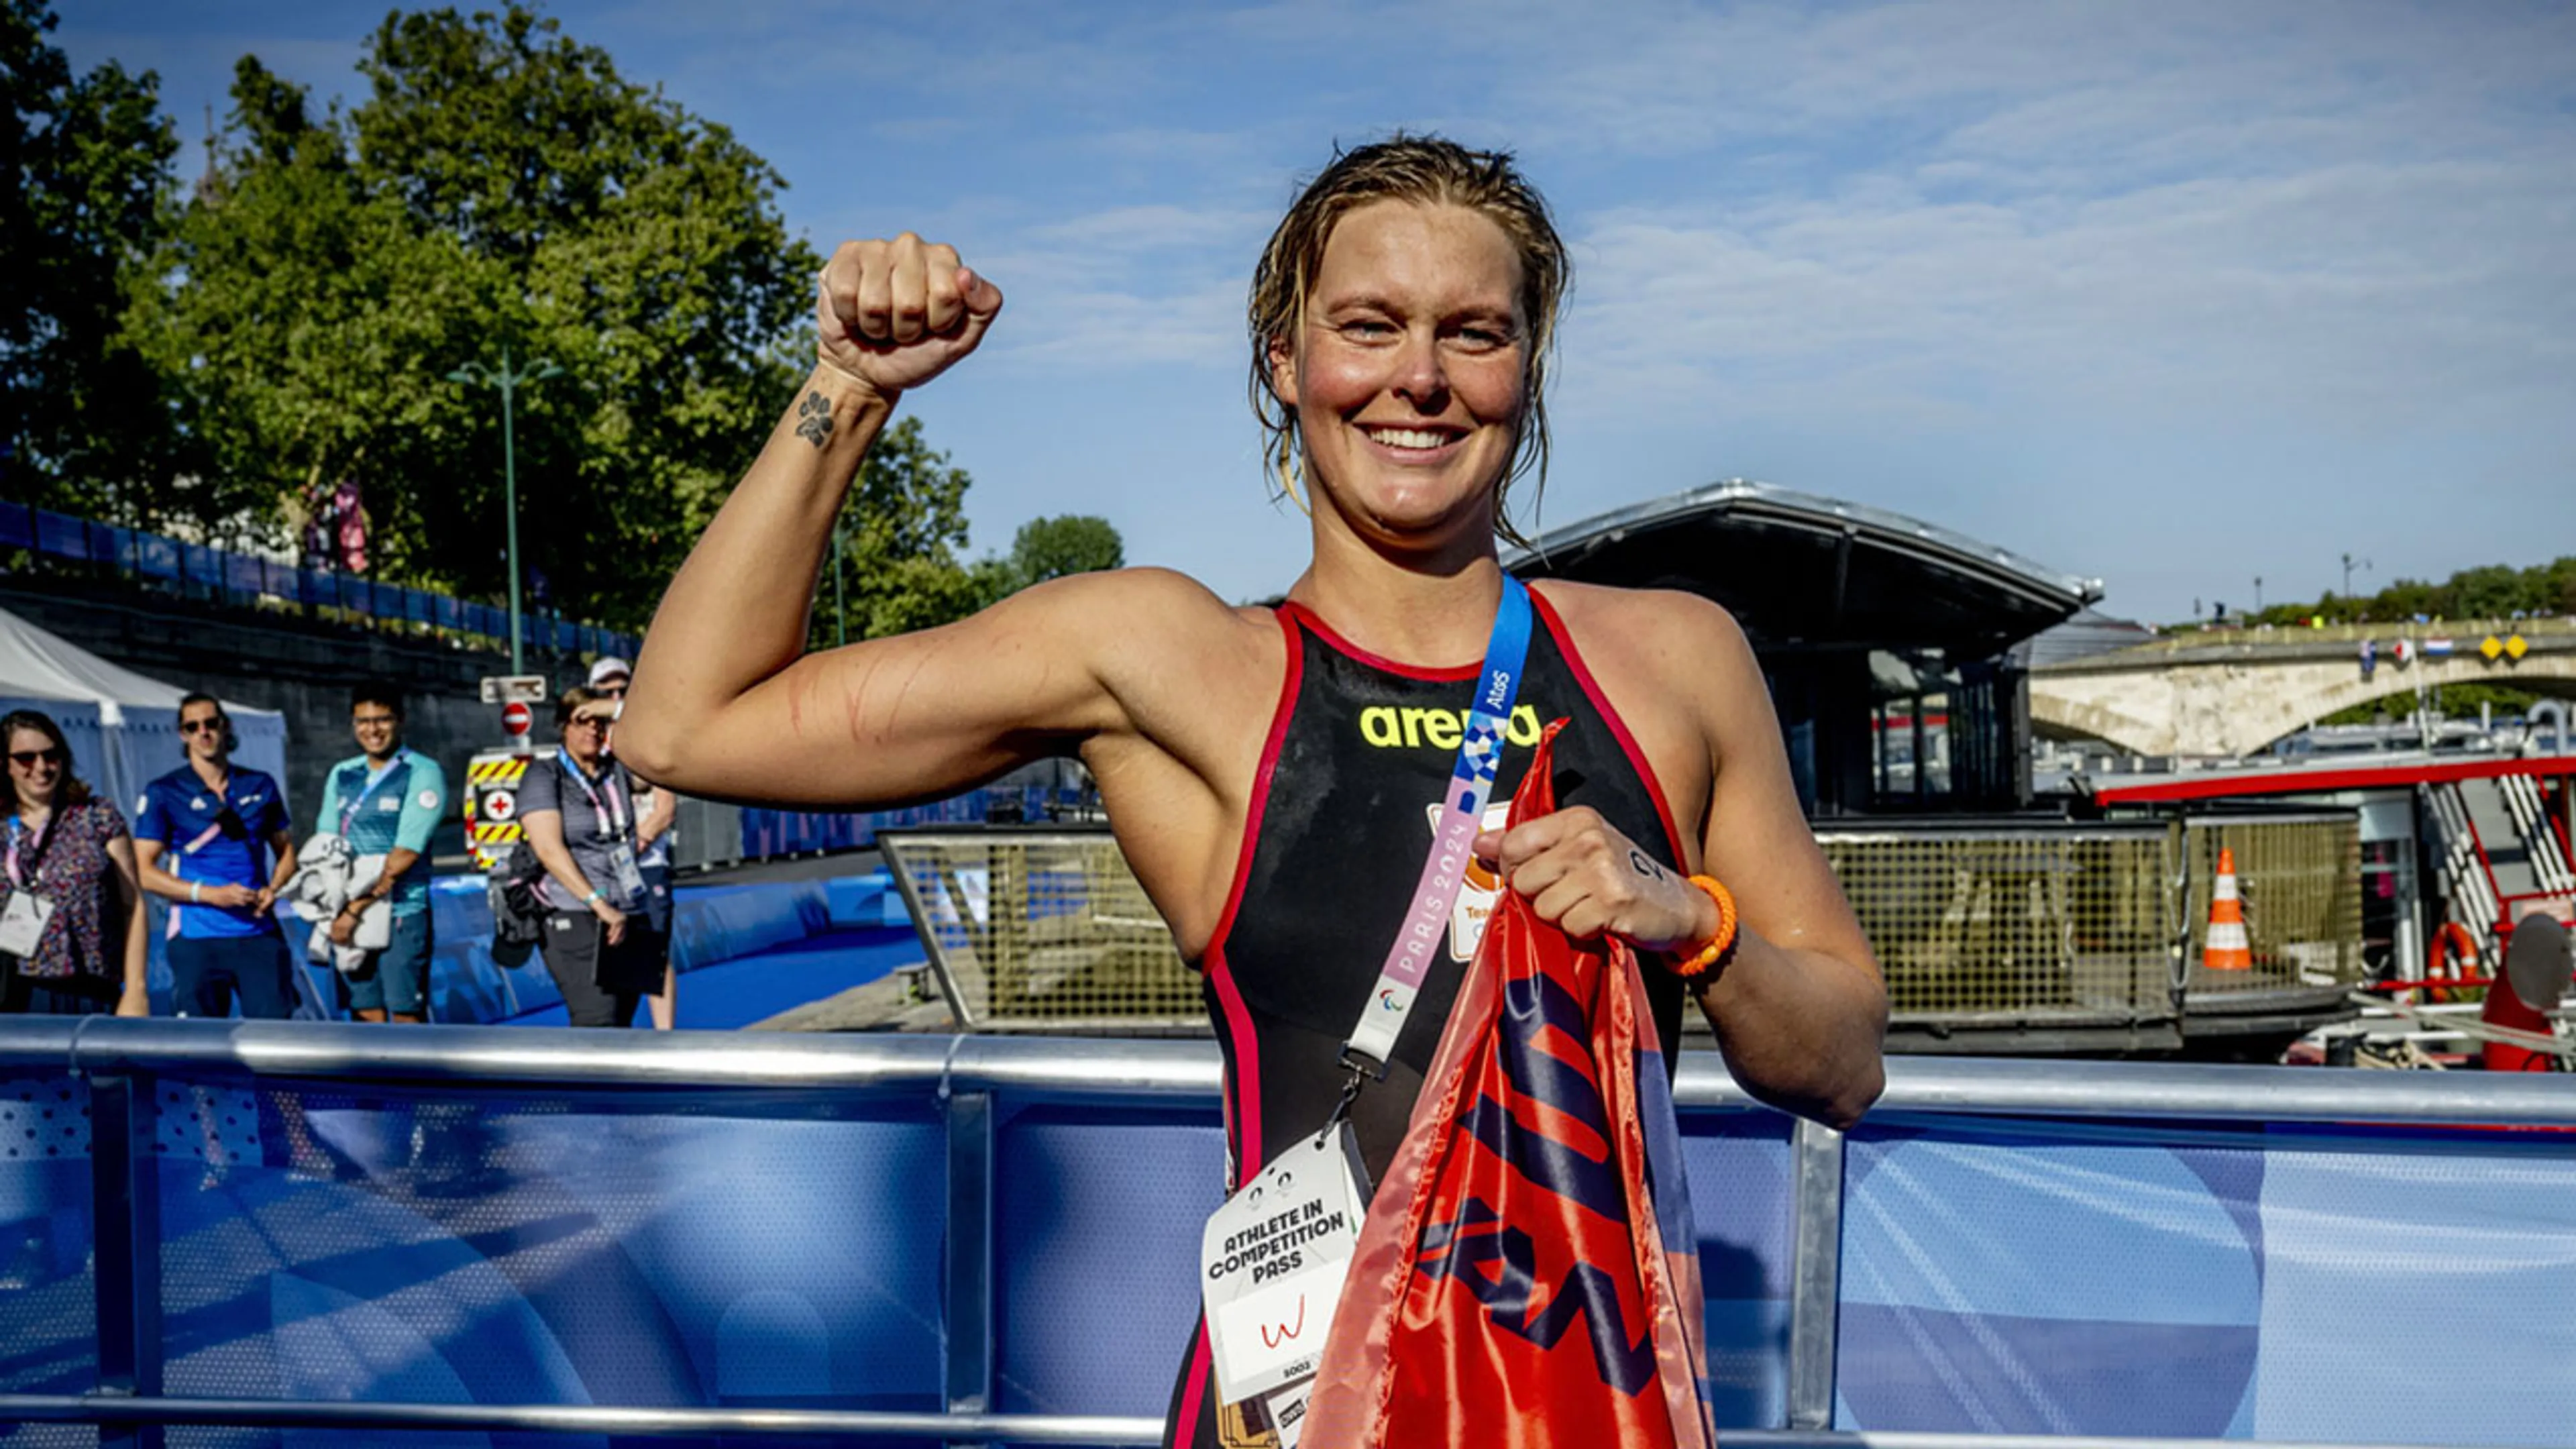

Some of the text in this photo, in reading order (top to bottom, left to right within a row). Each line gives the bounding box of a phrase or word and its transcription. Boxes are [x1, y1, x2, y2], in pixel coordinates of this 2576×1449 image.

[1360, 704, 1542, 750] area
[1399, 824, 1468, 973] PARIS 2024
[1209, 1211, 1344, 1279] COMPETITION
[1224, 1198, 1324, 1254] ATHLETE IN
[1252, 1250, 1303, 1284] PASS
